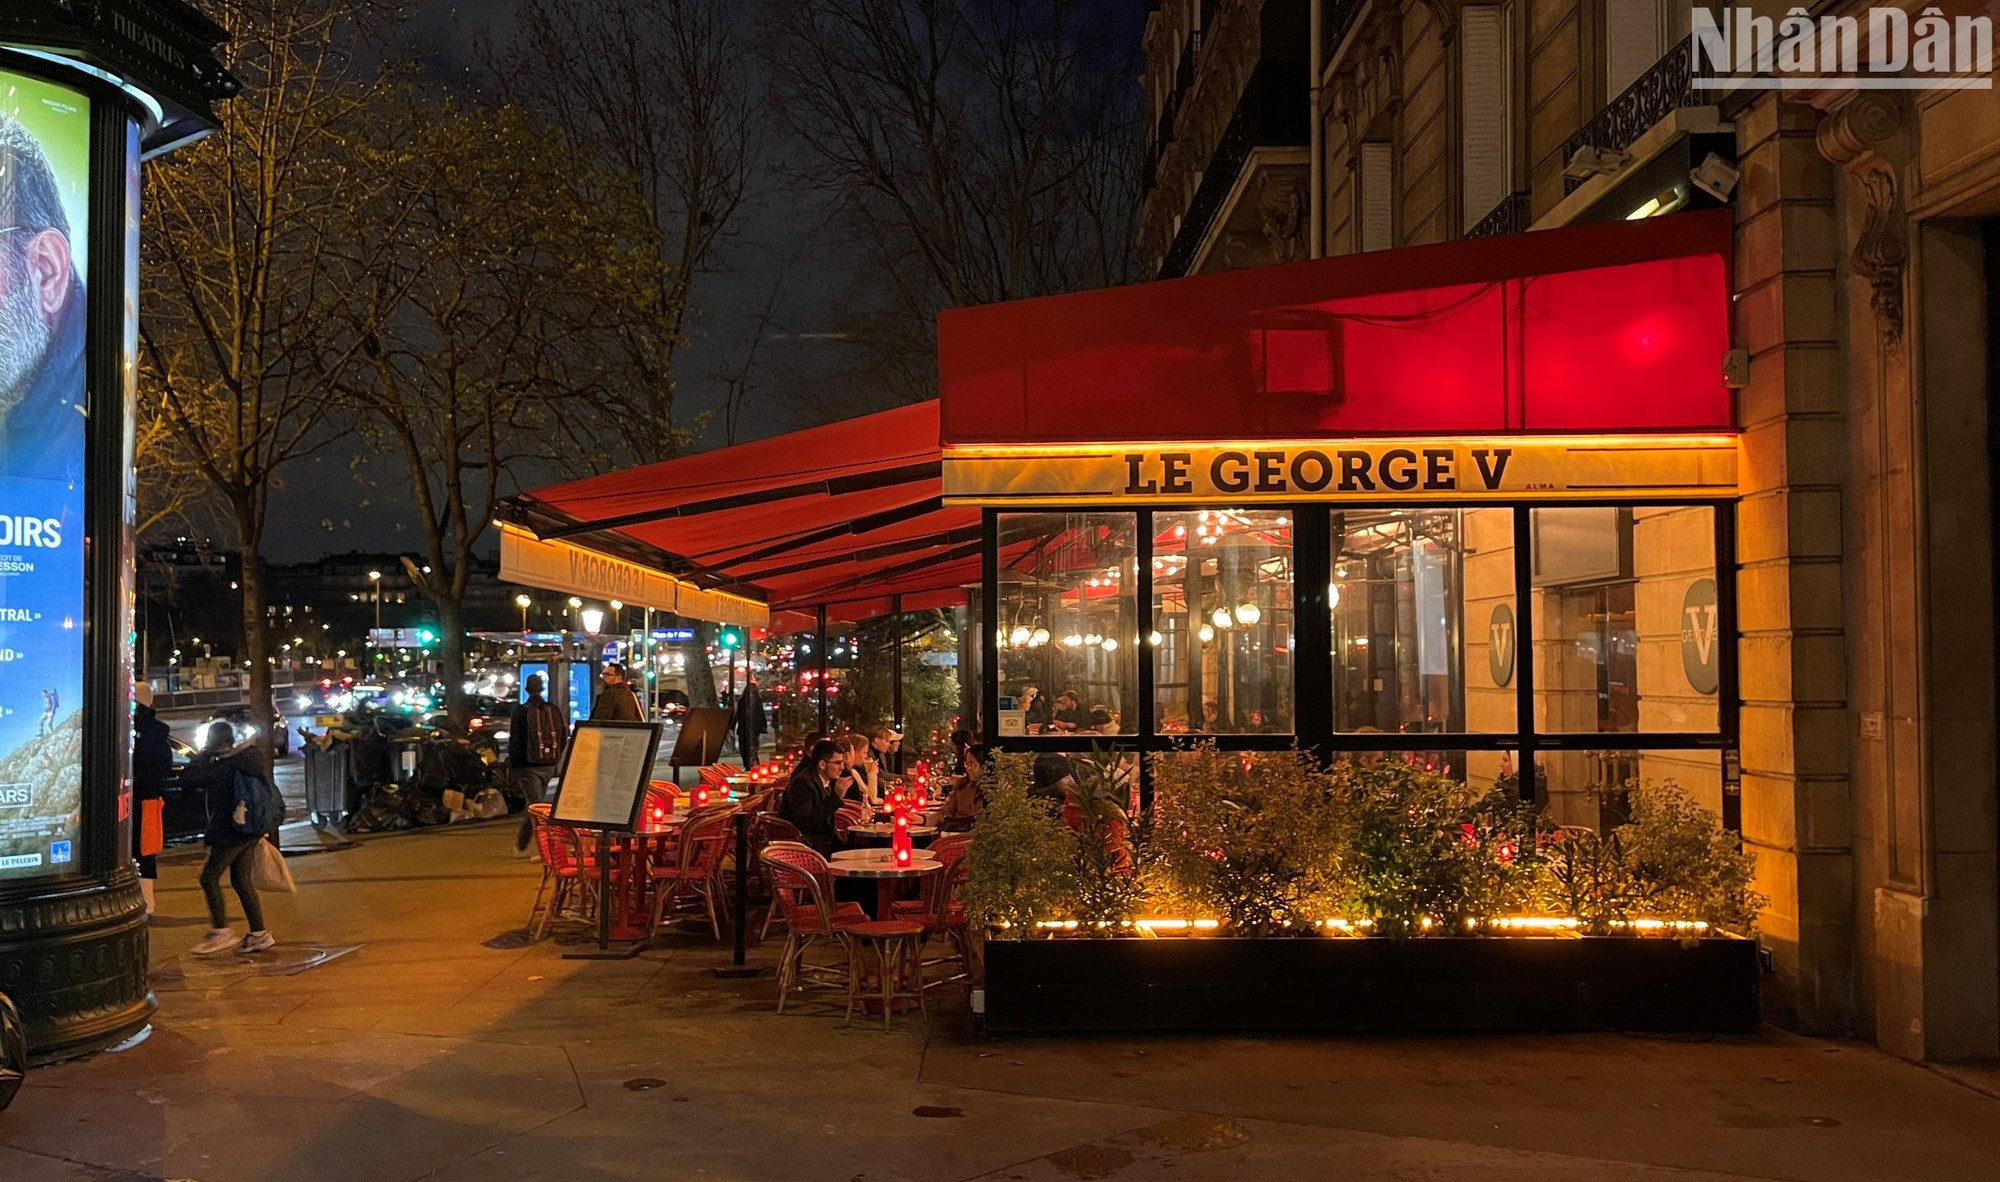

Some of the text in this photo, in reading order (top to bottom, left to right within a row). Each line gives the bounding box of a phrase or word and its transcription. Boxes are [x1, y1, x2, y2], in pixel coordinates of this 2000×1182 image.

[1125, 449, 1512, 494] LE GEORGE V
